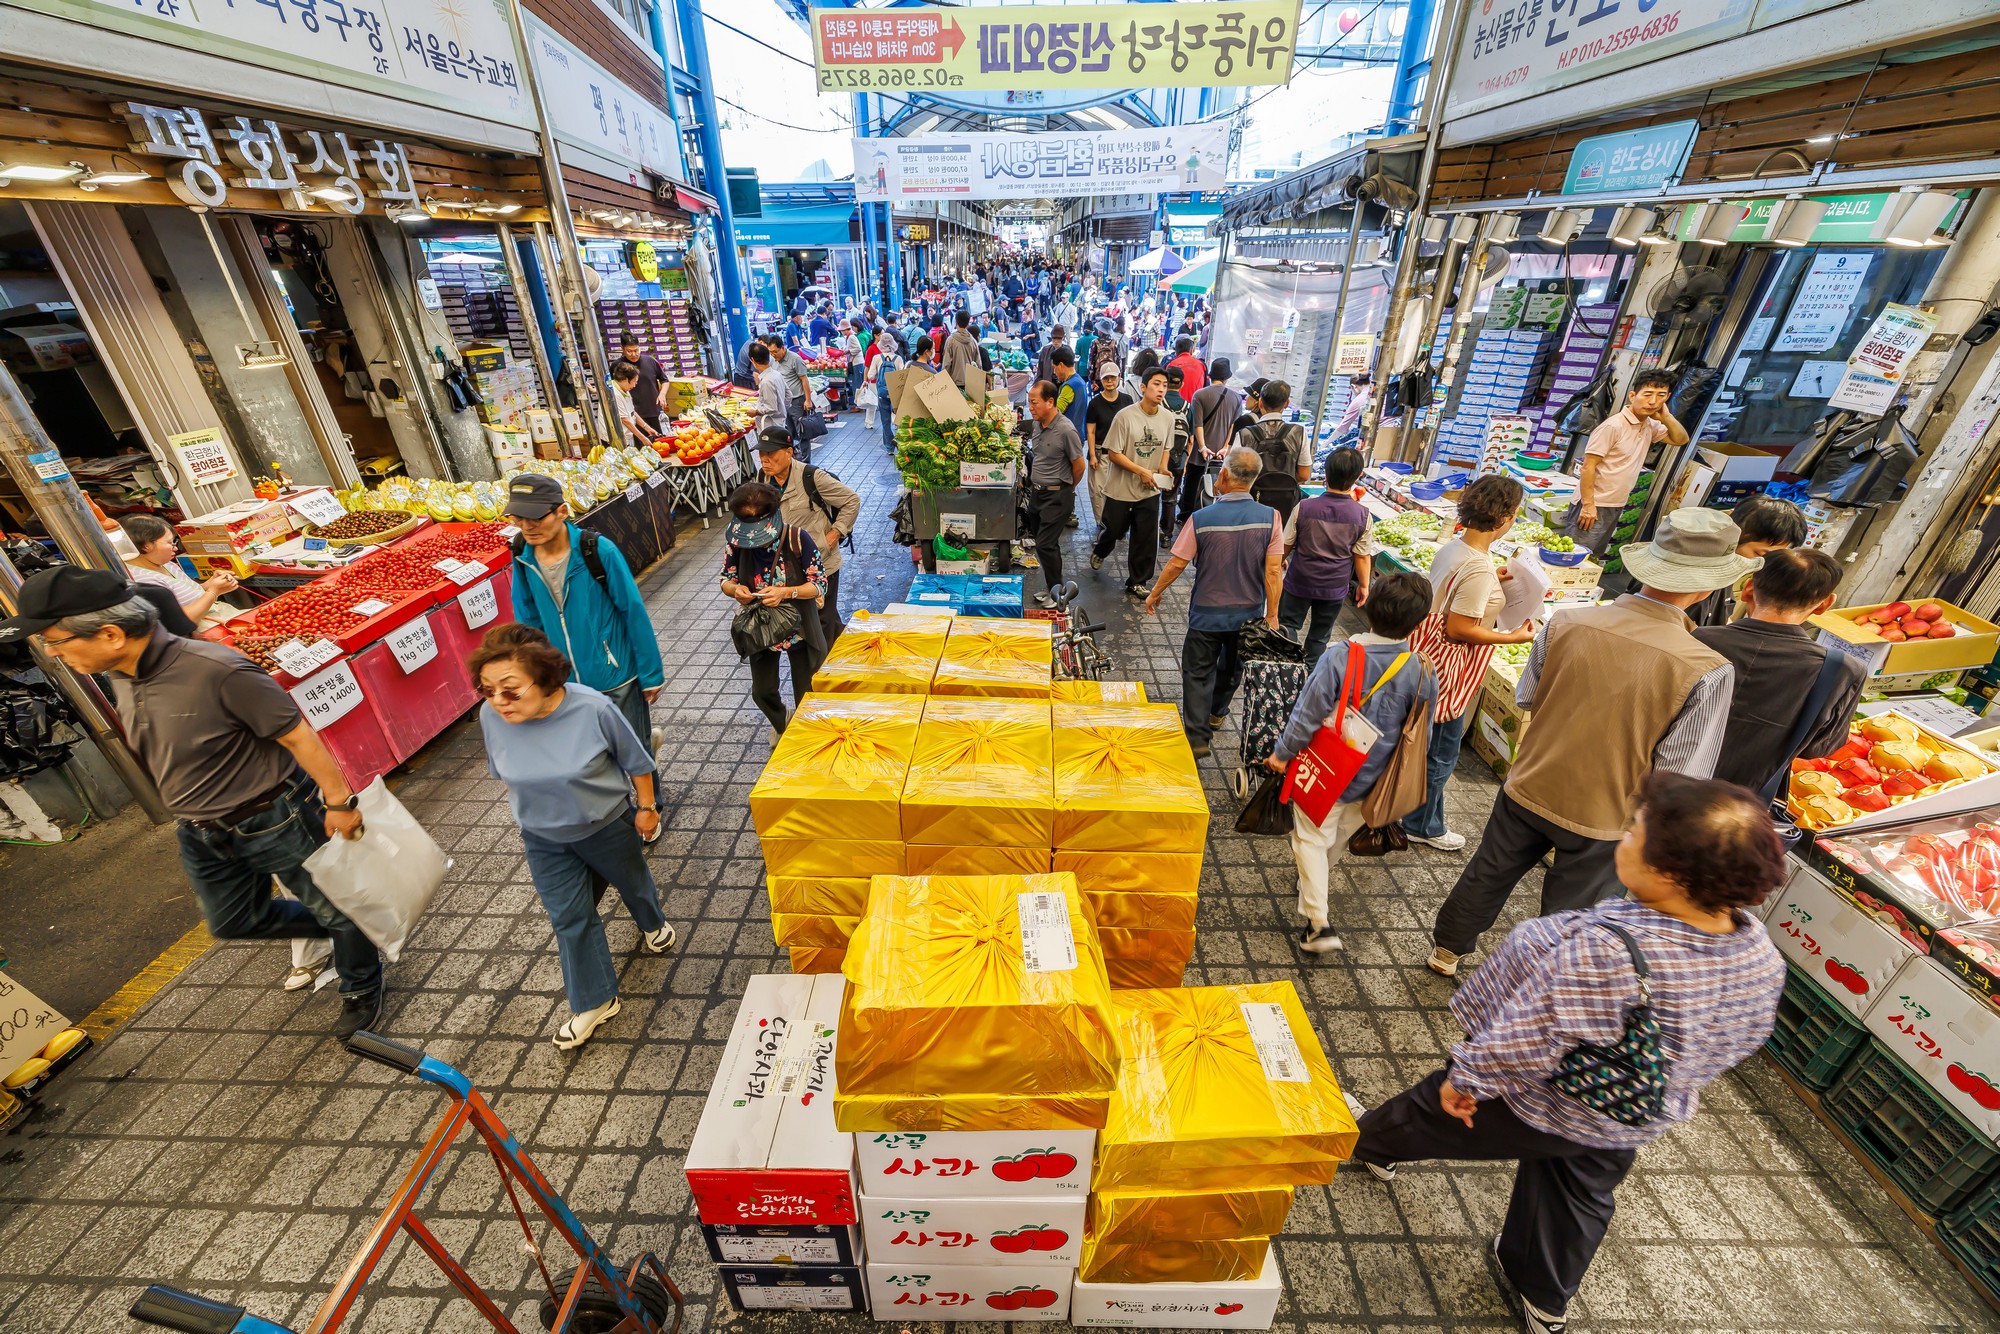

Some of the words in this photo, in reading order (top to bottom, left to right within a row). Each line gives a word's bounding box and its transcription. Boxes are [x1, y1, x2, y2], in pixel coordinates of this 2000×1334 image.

[373, 56, 389, 75] 2F
[404, 26, 520, 95] 서울은수교회
[112, 101, 421, 215] 평화상회
[1608, 139, 1679, 174] 한도상사
[1837, 257, 1847, 267] 9
[1873, 326, 1918, 349] 환급행사
[1342, 348, 1367, 356] 환급행사
[1863, 341, 1906, 363] 참여점포
[184, 445, 222, 461] 환급행사
[190, 456, 227, 472] 참여점포
[302, 496, 332, 510] 대추방울
[309, 511, 326, 519] 1kg
[467, 588, 492, 607] 대추방울
[469, 609, 483, 620] 1kg
[397, 626, 428, 649] 대추방울
[400, 650, 416, 663] 1kg
[305, 672, 346, 701] 대추방울
[309, 702, 330, 717] 1kg
[330, 682, 357, 704] 14000
[1295, 764, 1317, 794] 21
[1827, 864, 1856, 888] 사과
[1788, 904, 1812, 923] 산골
[1780, 921, 1822, 955] 사과
[1954, 960, 1992, 989] 사과
[1899, 996, 1931, 1019] 산골
[1887, 1015, 1943, 1059] 사과
[745, 1017, 787, 1103] 단양사과
[807, 1042, 833, 1092] 고냉지
[873, 1133, 927, 1149] 산골
[883, 1157, 980, 1177] 사과
[761, 1195, 802, 1205] 고냉지
[737, 1202, 813, 1218] 단양사과
[881, 1210, 931, 1224] 산골
[890, 1230, 980, 1248] 사과
[886, 1275, 931, 1287] 산골
[893, 1292, 975, 1306] 사과
